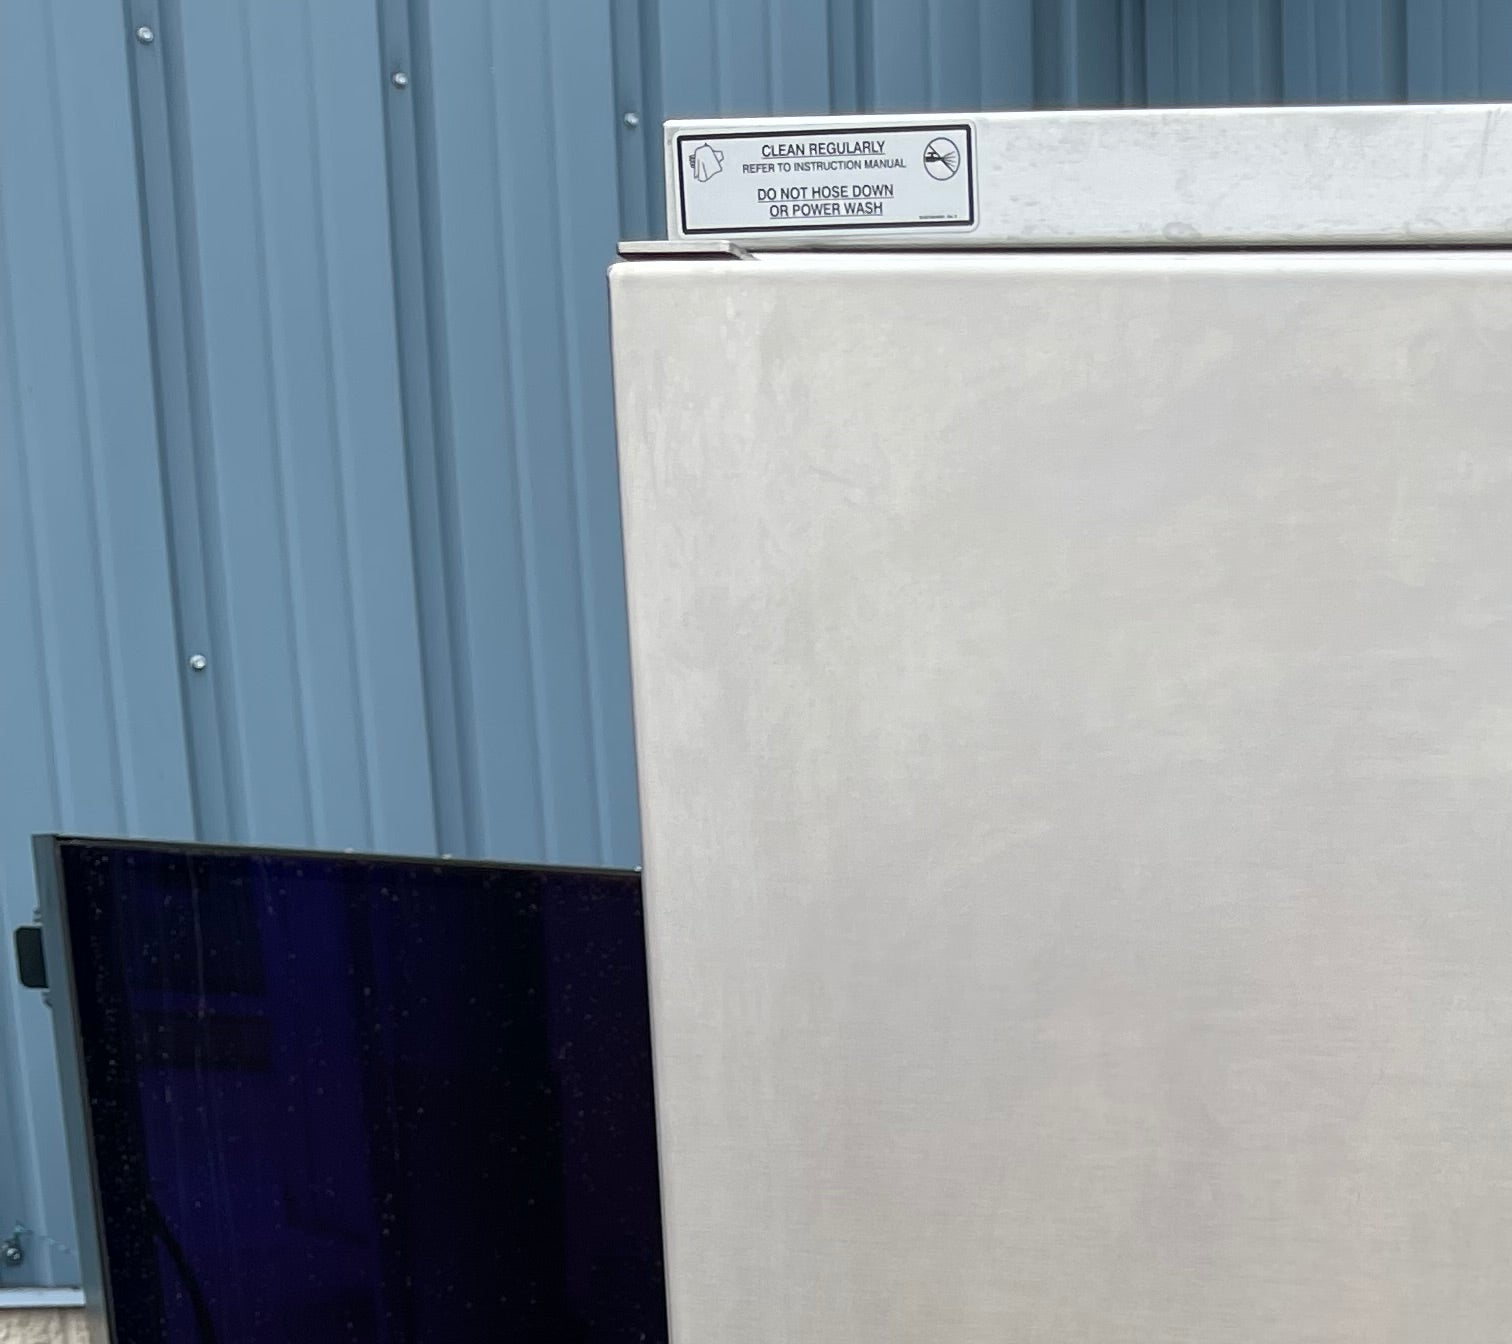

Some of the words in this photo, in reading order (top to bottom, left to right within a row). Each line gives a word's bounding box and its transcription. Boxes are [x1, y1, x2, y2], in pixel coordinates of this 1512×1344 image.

[762, 144, 805, 157] CLEAN
[809, 141, 885, 155] REGULARLY
[742, 163, 774, 174] REFER
[776, 162, 791, 173] TO
[794, 160, 861, 172] INSTRUCTION
[864, 157, 906, 170] MANUAL
[757, 187, 777, 200] DO
[780, 186, 808, 200] NOT
[812, 185, 848, 199] HOSE
[852, 184, 894, 198] DOWN
[770, 204, 789, 217] OR
[792, 203, 841, 216] POWER
[844, 201, 883, 215] WASH
